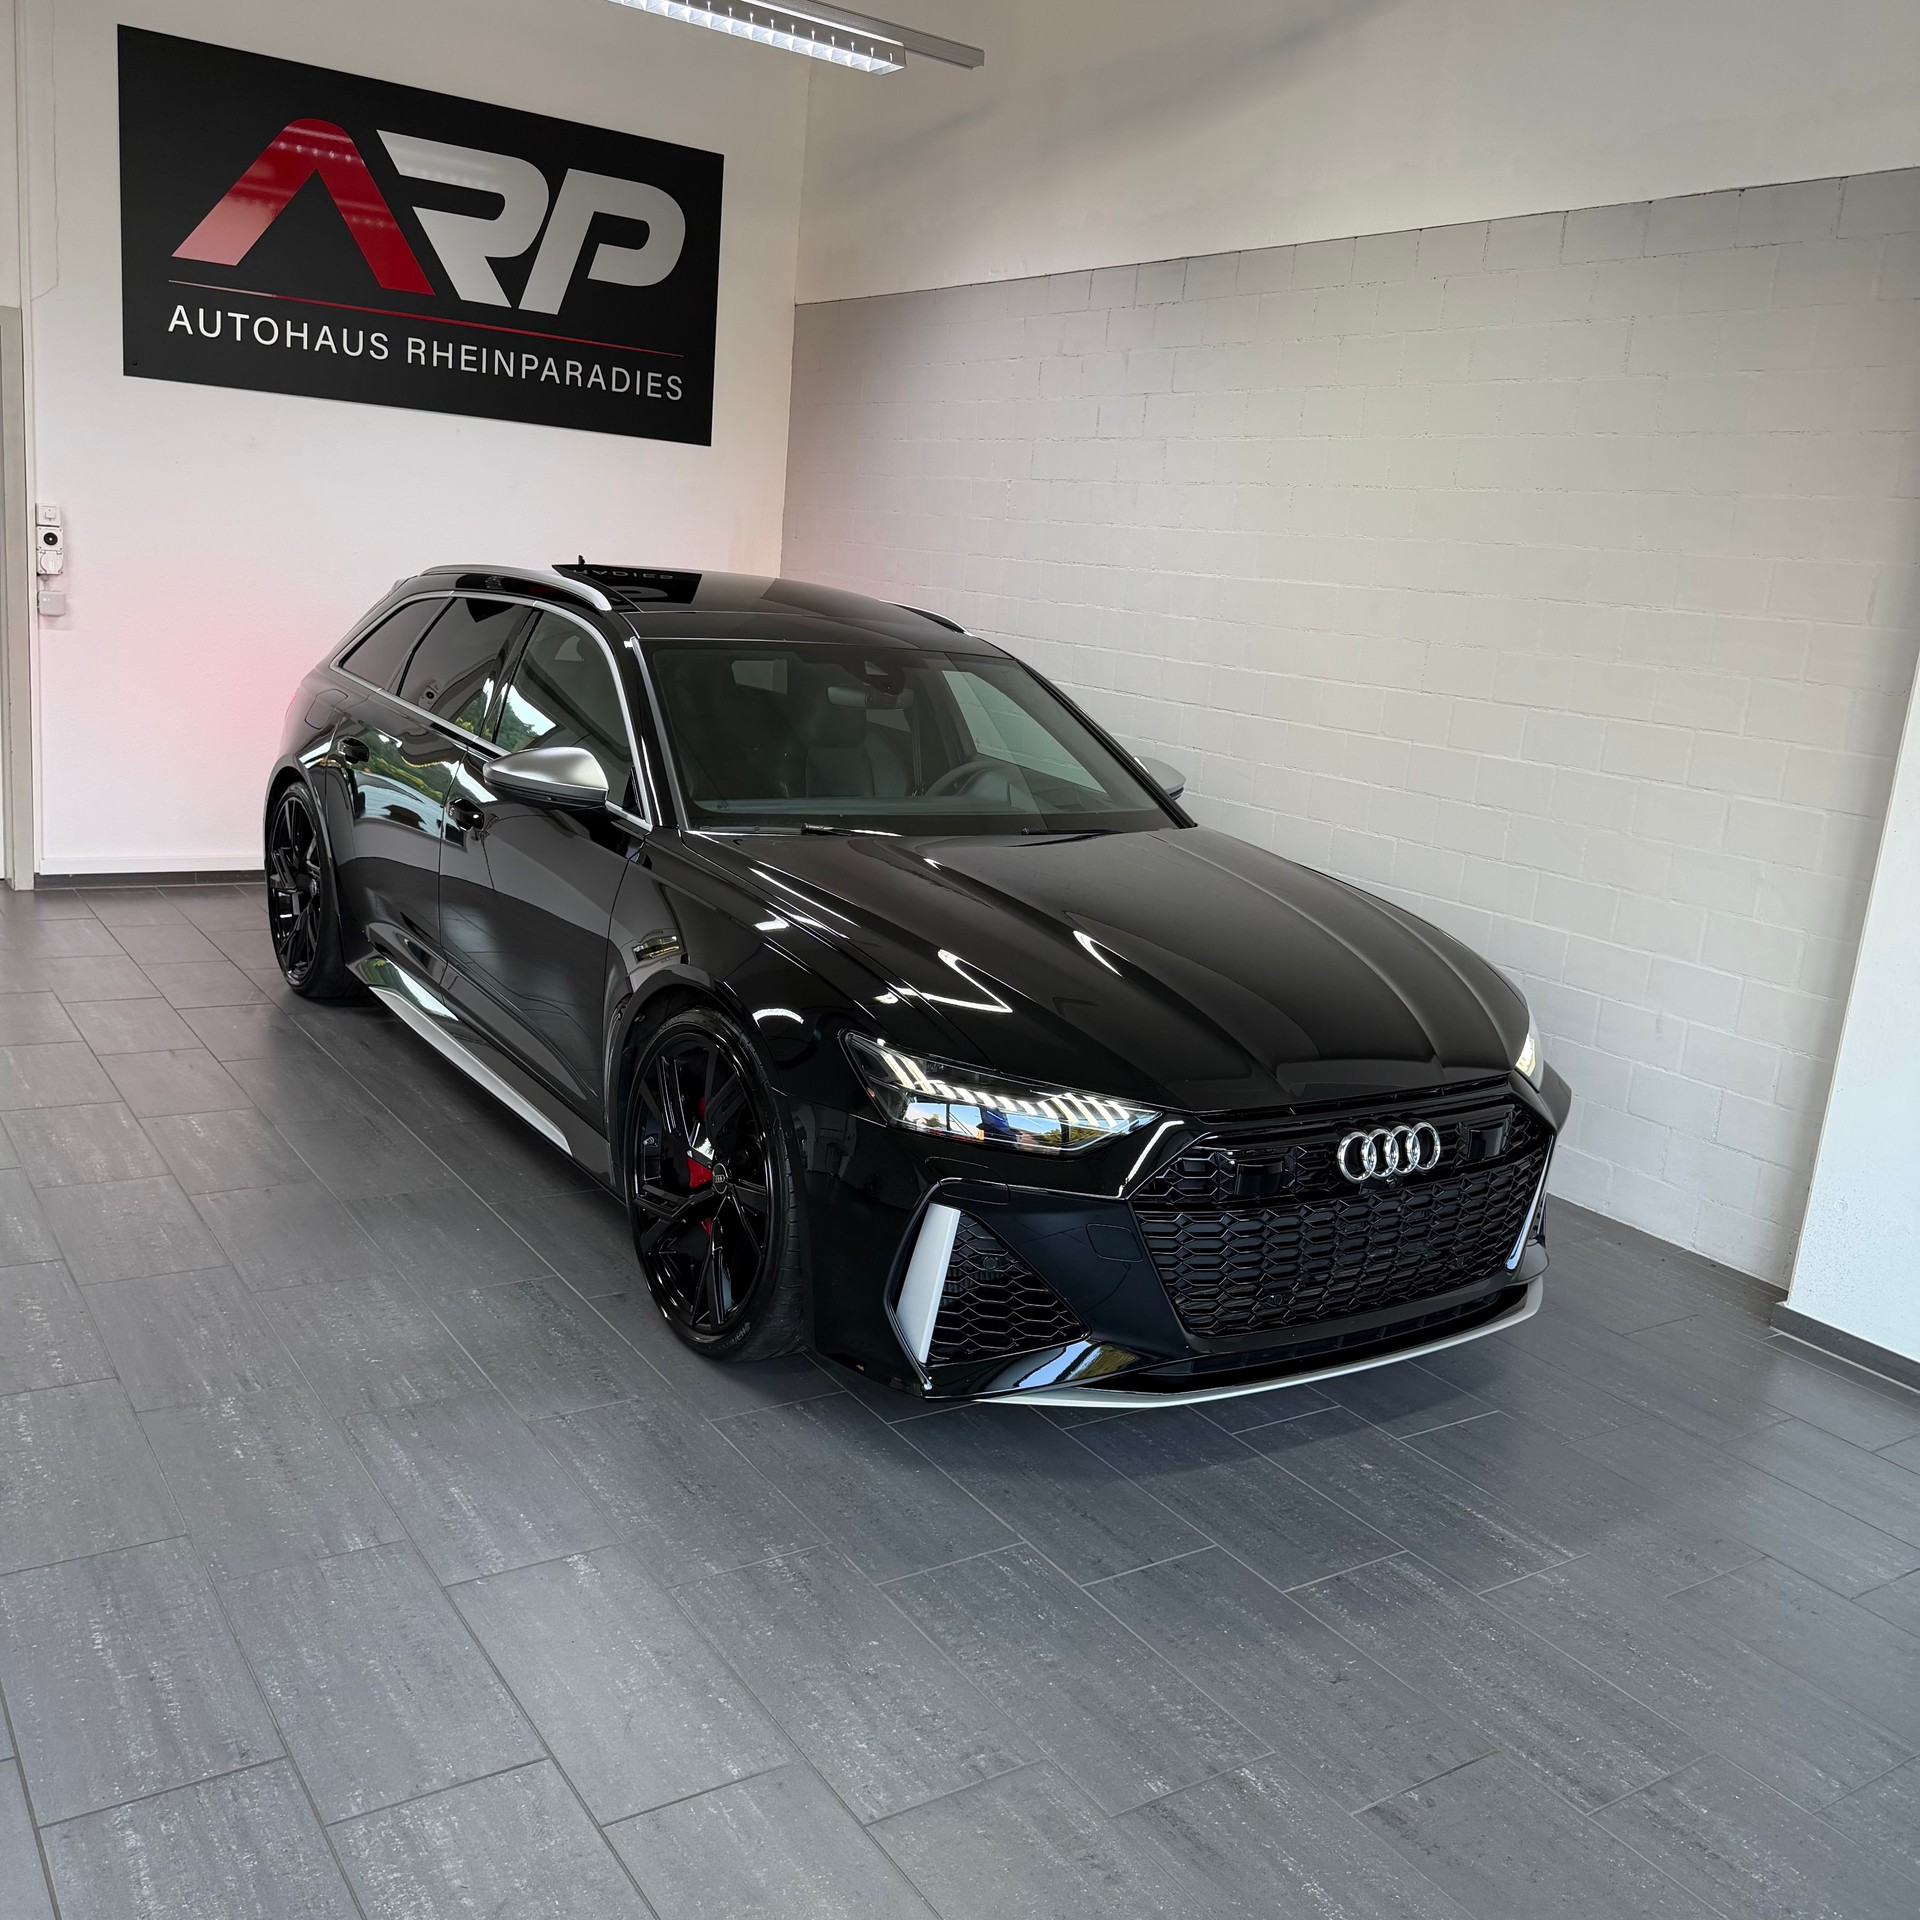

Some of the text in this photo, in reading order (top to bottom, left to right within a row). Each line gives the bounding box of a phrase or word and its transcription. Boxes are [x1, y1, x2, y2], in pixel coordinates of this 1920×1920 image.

[170, 118, 686, 316] ARP
[167, 304, 683, 402] AUTOHAUS RHEINPARADIES
